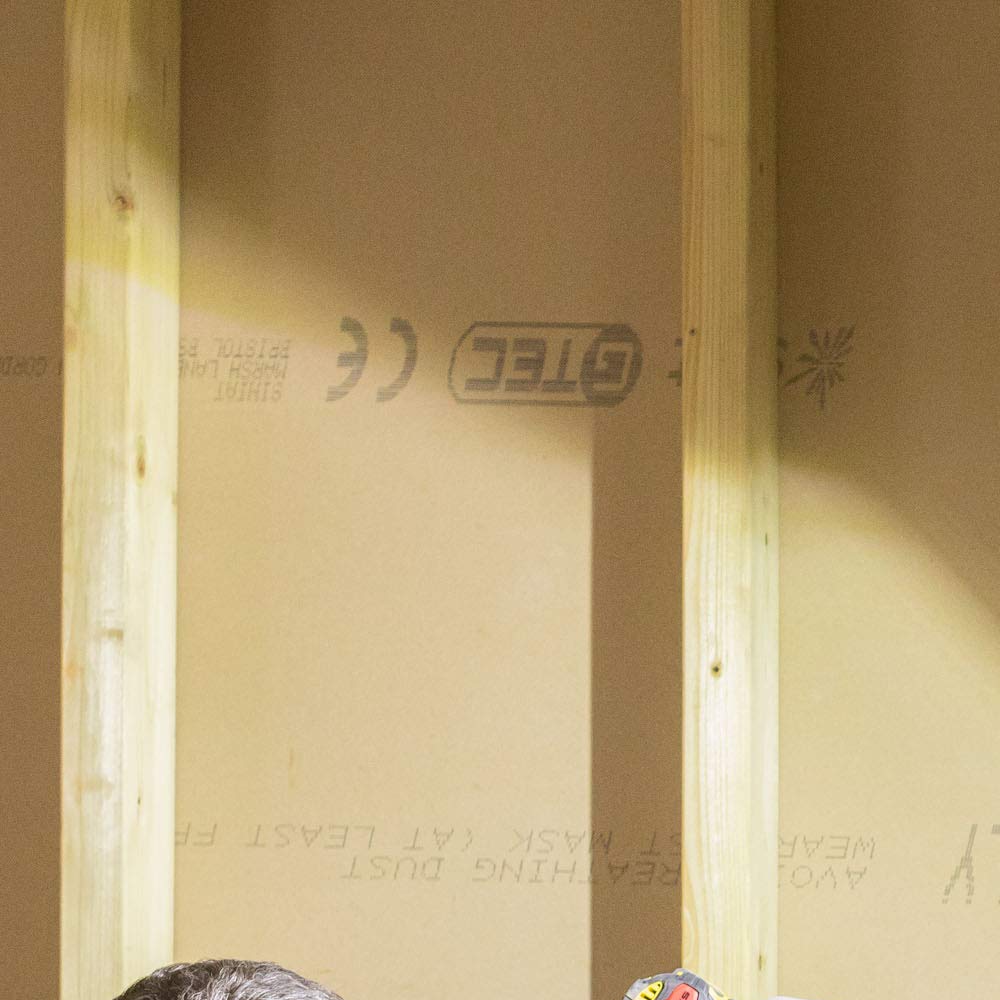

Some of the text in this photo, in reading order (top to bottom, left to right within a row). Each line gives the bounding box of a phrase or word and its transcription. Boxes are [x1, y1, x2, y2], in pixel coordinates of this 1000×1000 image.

[460, 328, 640, 400] GTEC
[246, 823, 376, 850] LEAST
[508, 829, 612, 855] MASK
[340, 855, 445, 882] DUST
[472, 857, 682, 888] REATHING
